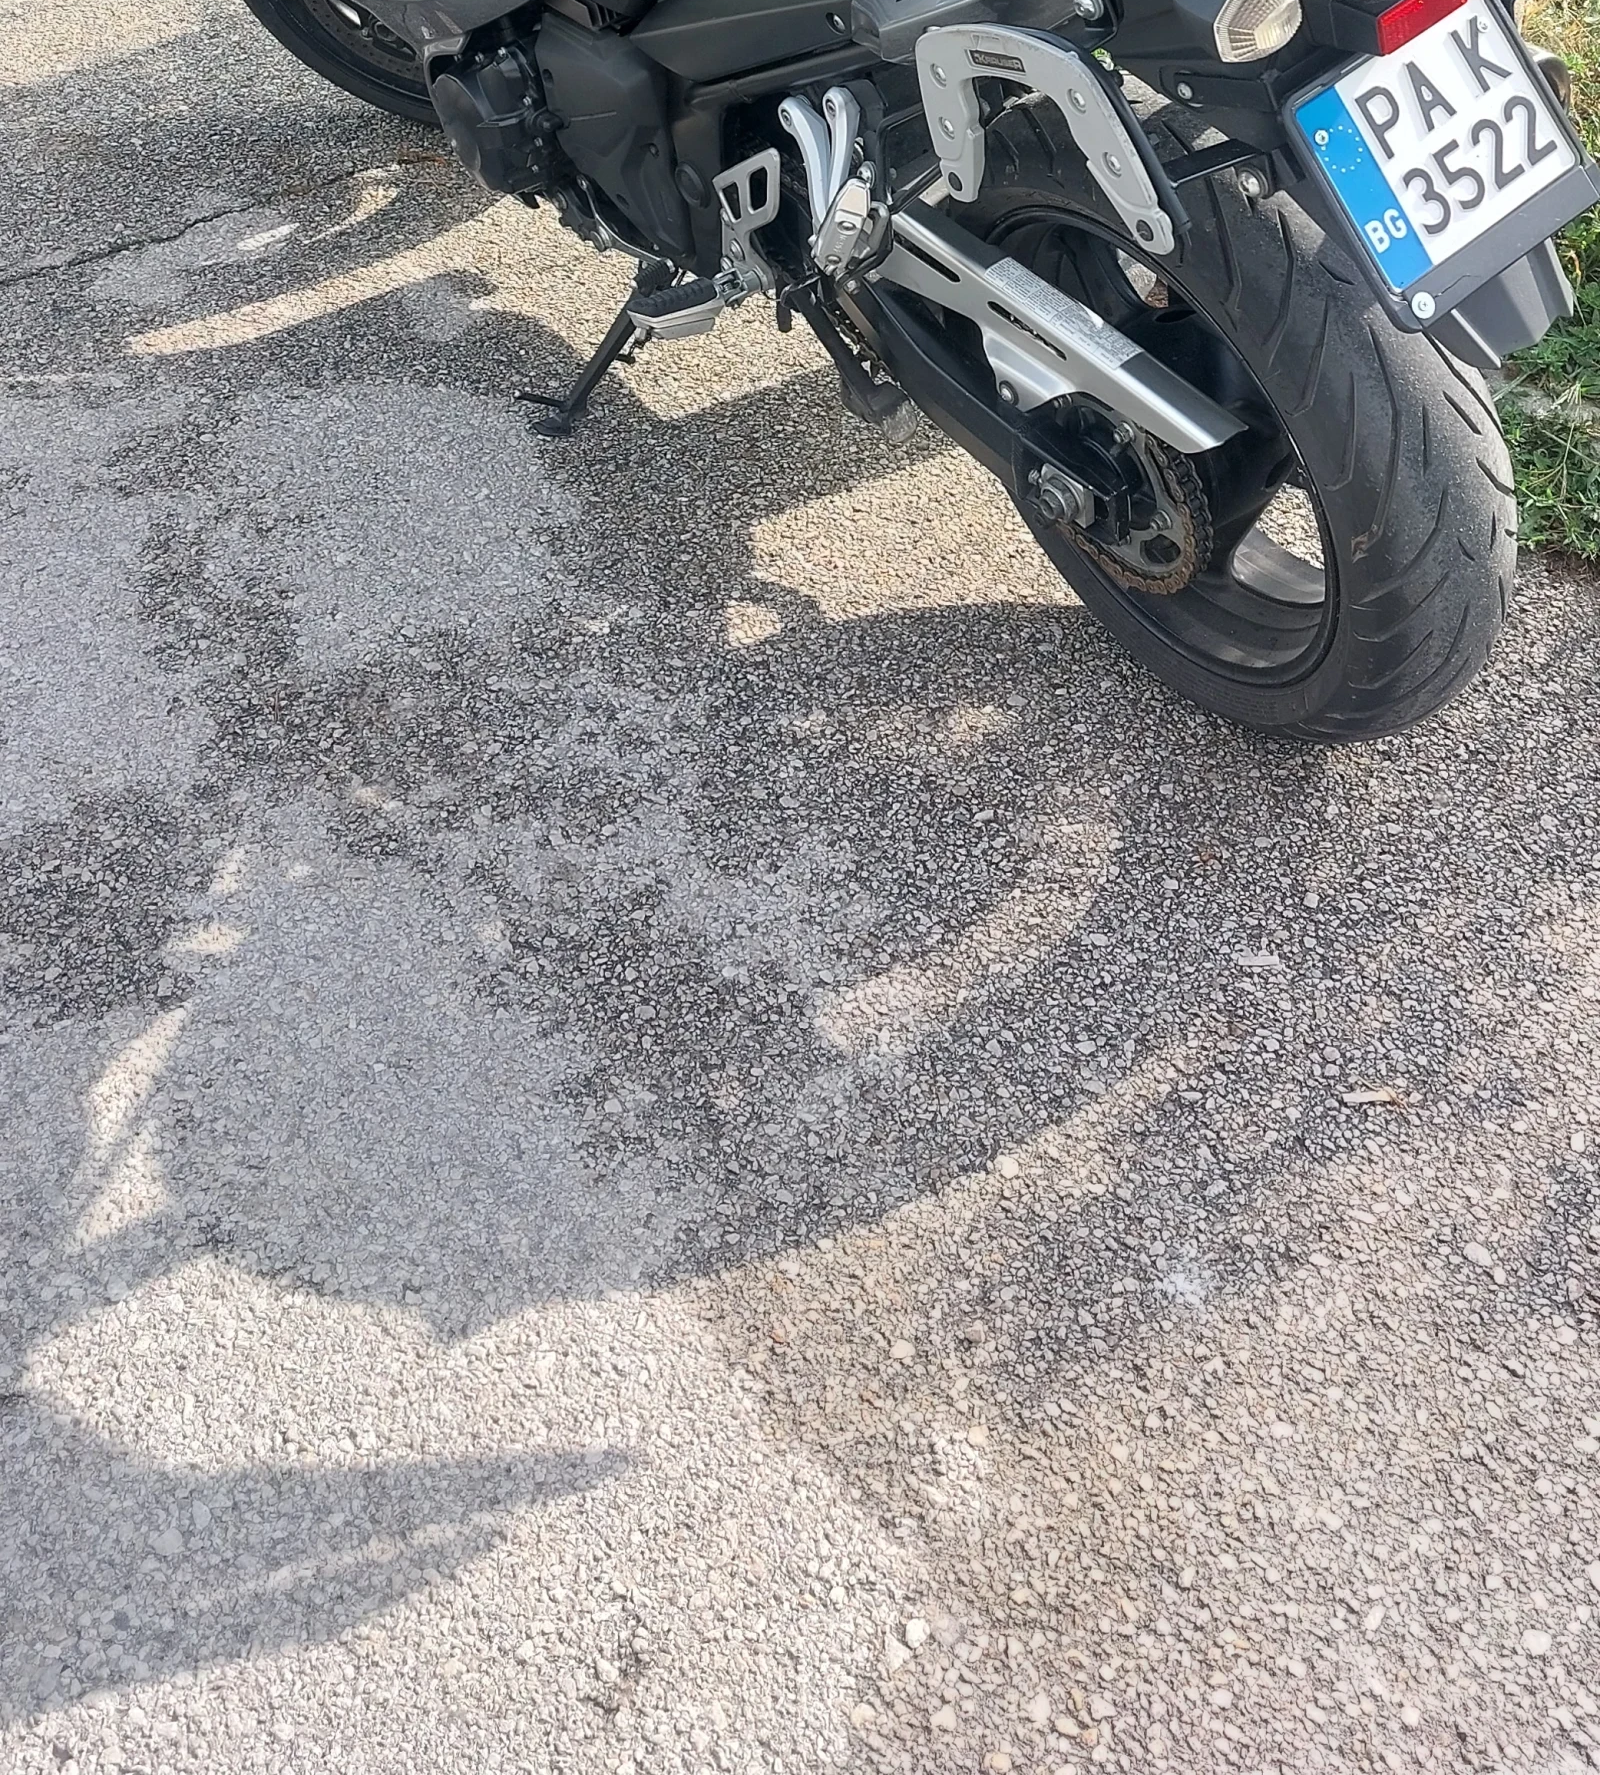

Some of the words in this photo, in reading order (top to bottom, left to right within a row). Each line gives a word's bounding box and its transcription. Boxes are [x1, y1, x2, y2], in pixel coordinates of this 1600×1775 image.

[1354, 61, 1457, 160] PA
[1450, 15, 1513, 93] K
[1364, 208, 1408, 253] BG
[1403, 95, 1558, 235] 3522
